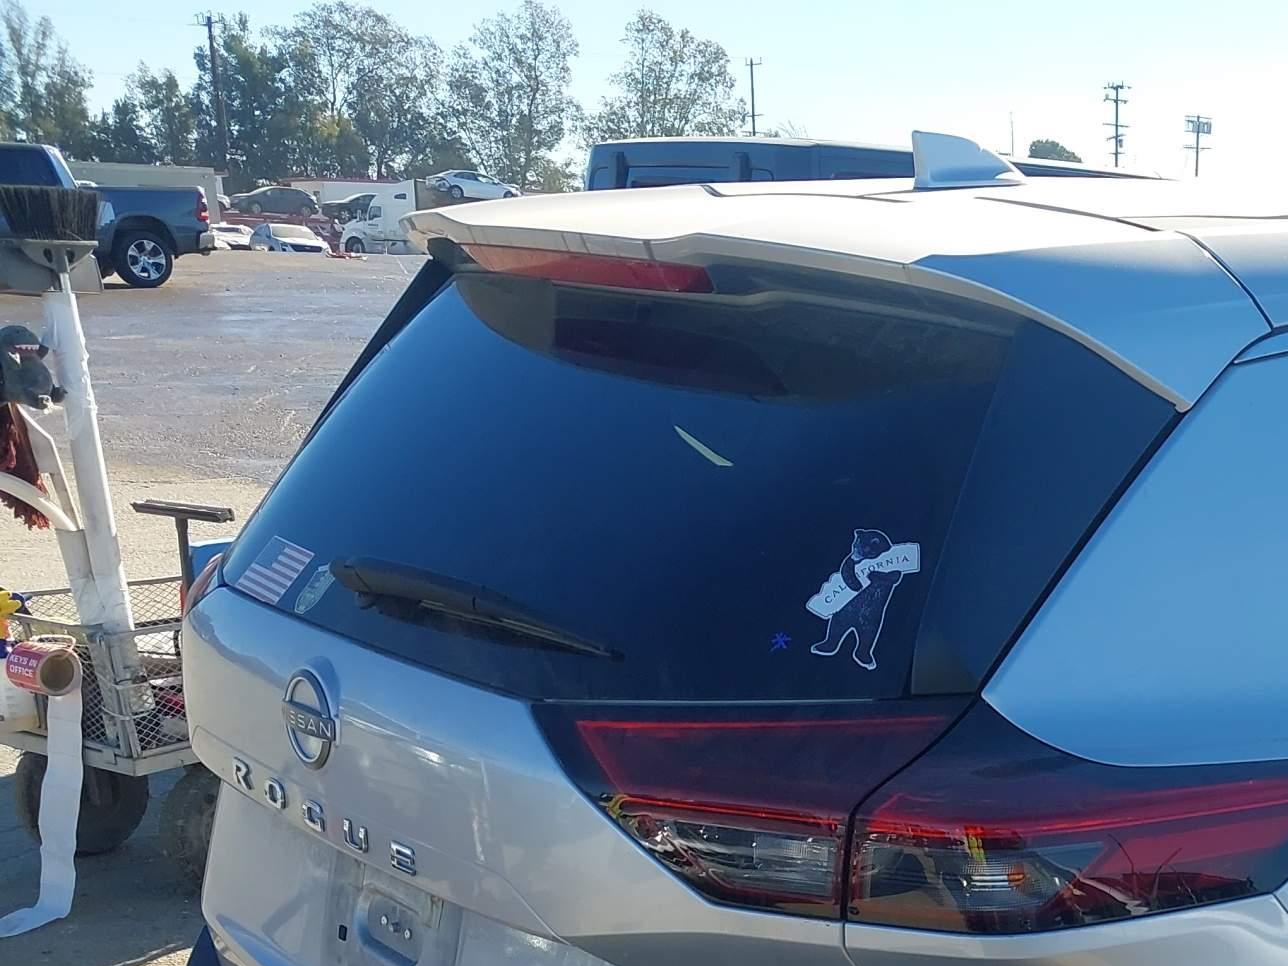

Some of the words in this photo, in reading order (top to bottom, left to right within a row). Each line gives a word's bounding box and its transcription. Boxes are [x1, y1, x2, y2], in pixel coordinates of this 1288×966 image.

[9, 654, 28, 665] KEYS
[28, 660, 38, 668] IN
[9, 665, 33, 678] OFFICE
[286, 707, 331, 738] SSAN
[232, 756, 416, 876] ROGUE
